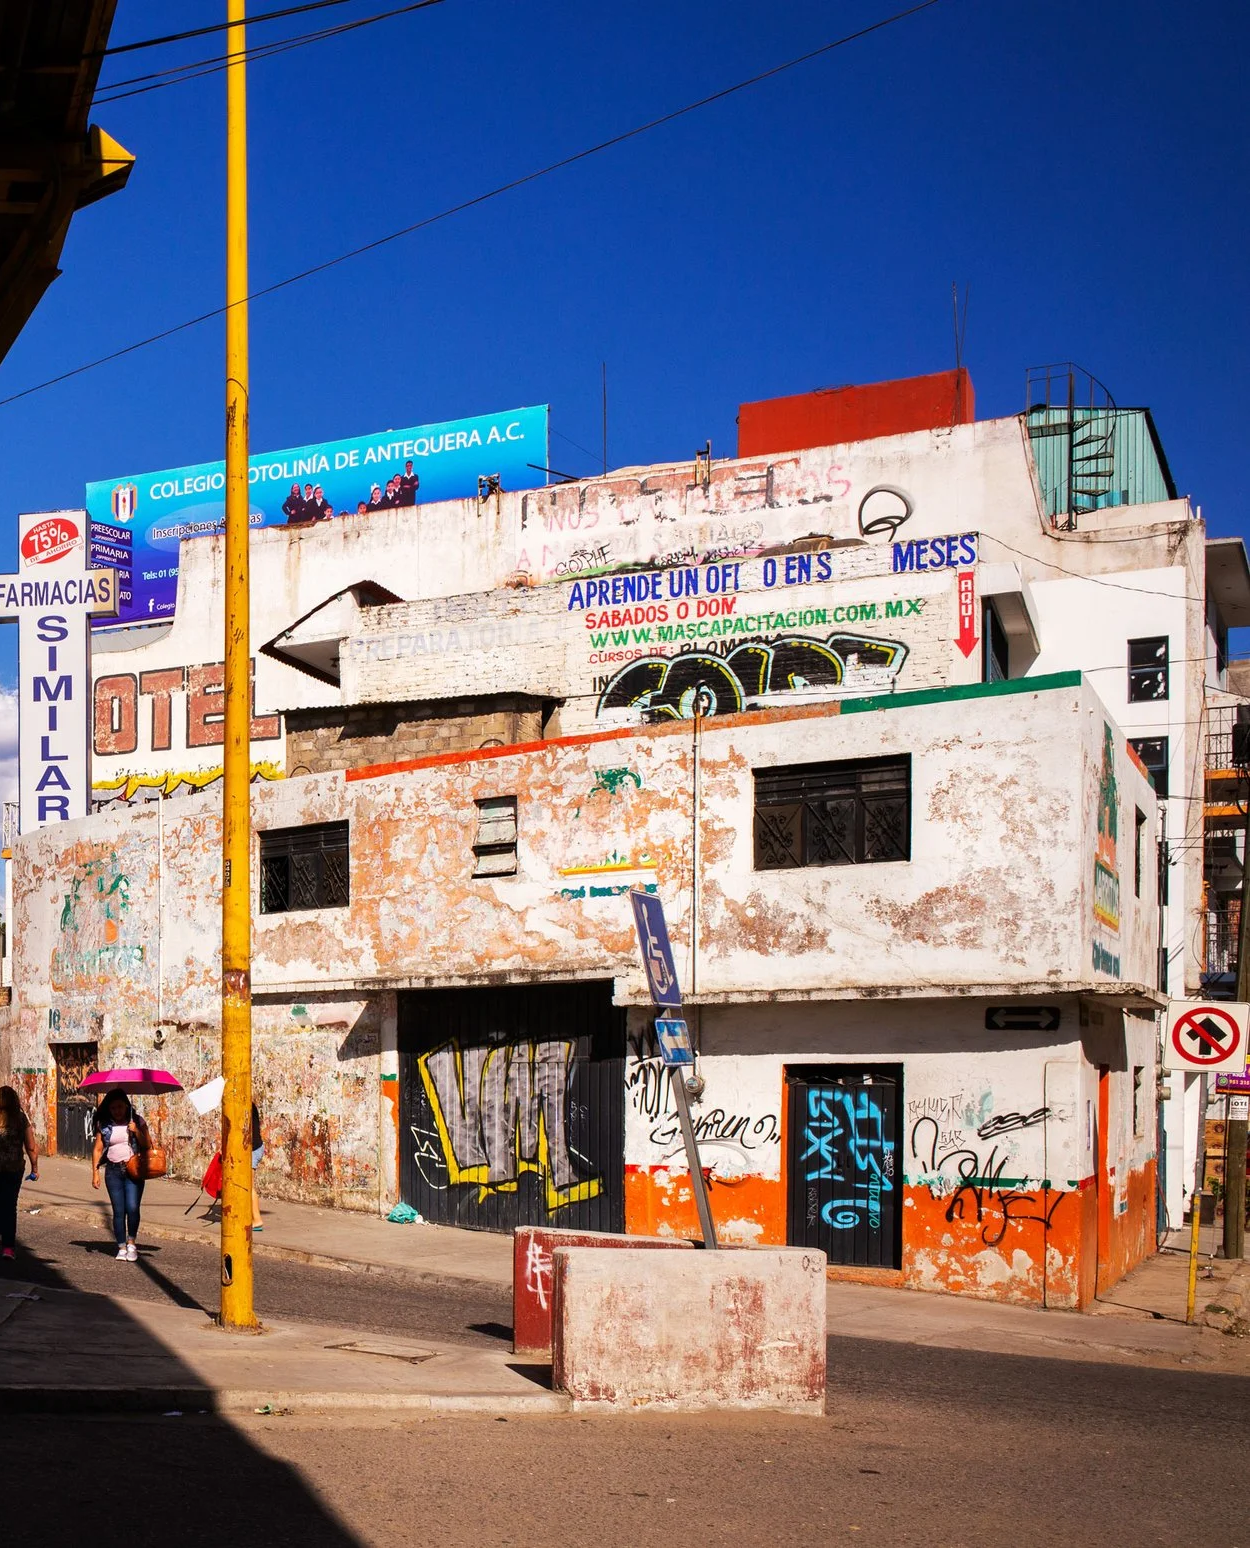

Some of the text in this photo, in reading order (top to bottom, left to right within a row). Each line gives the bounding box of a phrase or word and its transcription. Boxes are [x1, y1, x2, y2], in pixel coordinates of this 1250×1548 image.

[150, 422, 524, 500] COLEGIO OTOLINÍA DE ANTEQUERA A.C.
[29, 523, 69, 554] 75%
[33, 521, 55, 534] HASTA
[91, 523, 131, 540] PREESCOLAR
[30, 539, 78, 564] DE AHORRO
[90, 543, 129, 559] PRIMARIA
[158, 569, 167, 579] 01
[568, 572, 663, 610] APRENDE
[669, 567, 698, 598] UN
[785, 553, 812, 585] EN
[892, 534, 976, 573] MESES
[585, 604, 669, 630] SABADOS
[676, 602, 689, 620] O
[960, 579, 974, 629] AQUI
[589, 648, 643, 664] CURSOS
[32, 615, 73, 827] SIMILAR
[93, 657, 282, 757] OTEL
